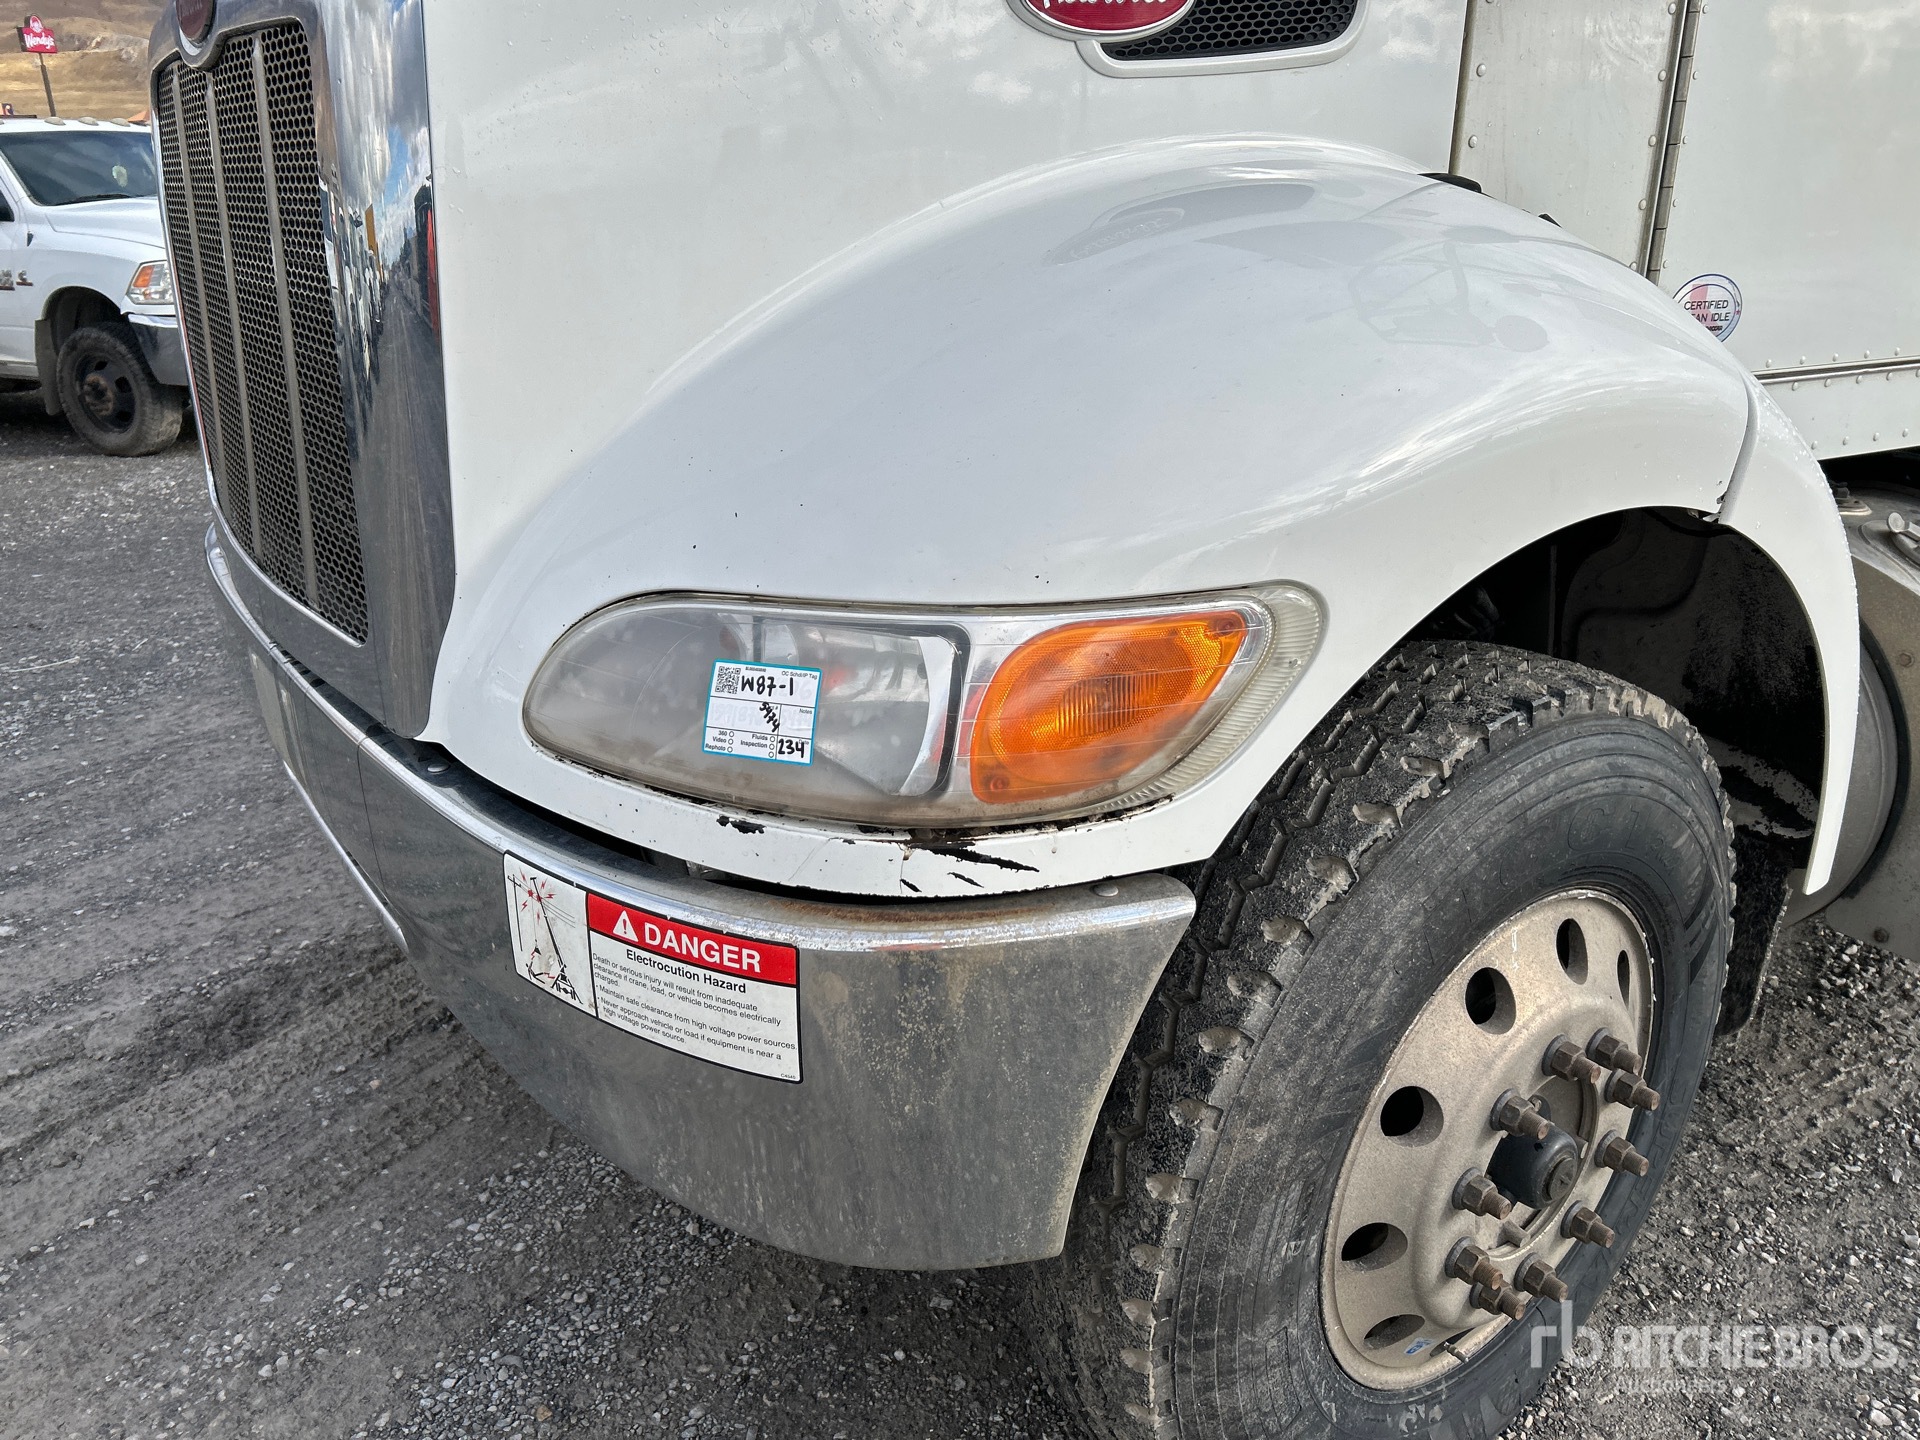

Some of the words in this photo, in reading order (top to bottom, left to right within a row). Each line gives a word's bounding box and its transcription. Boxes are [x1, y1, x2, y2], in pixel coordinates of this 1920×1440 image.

[23, 32, 55, 49] Wendy's
[1684, 300, 1729, 311] CERTIFIED
[1710, 312, 1731, 322] IDLE
[741, 675, 794, 697] W87-1
[704, 743, 726, 752] Rephoto
[740, 739, 768, 749] Inspection
[752, 733, 768, 741] Fluids
[778, 738, 805, 759] 234
[644, 921, 761, 973] DANGER
[594, 972, 620, 988] charged.
[626, 948, 700, 982] Electrocution
[703, 973, 746, 993] Hazard
[593, 952, 611, 967] Death
[620, 965, 643, 979] serious
[643, 973, 661, 986] injury
[663, 980, 675, 989] will
[675, 985, 696, 996] result
[697, 990, 714, 1001] from
[715, 997, 758, 1012] inadequate
[593, 963, 622, 980] clearance
[628, 977, 649, 990] crane,
[650, 984, 666, 997] load,
[677, 994, 702, 1007] vehicle
[703, 1001, 738, 1017] becomes
[739, 1011, 782, 1027] electrically
[600, 984, 625, 1001] Maintain
[626, 996, 640, 1007] safe
[640, 1003, 673, 1019] clearance
[674, 1013, 690, 1025] from
[691, 1019, 707, 1030] high
[708, 1025, 736, 1038] voltage
[737, 1032, 761, 1044] power
[763, 1038, 797, 1050] sources.
[601, 996, 618, 1009] Never
[619, 1006, 649, 1022] approach
[650, 1017, 674, 1031] vehicle
[684, 1028, 699, 1039] load
[706, 1037, 746, 1052] equipment
[747, 1047, 754, 1055] is
[755, 1049, 774, 1058] near
[602, 1006, 616, 1018] high
[617, 1013, 640, 1027] voltage
[640, 1022, 661, 1035] power
[661, 1030, 687, 1044] source.
